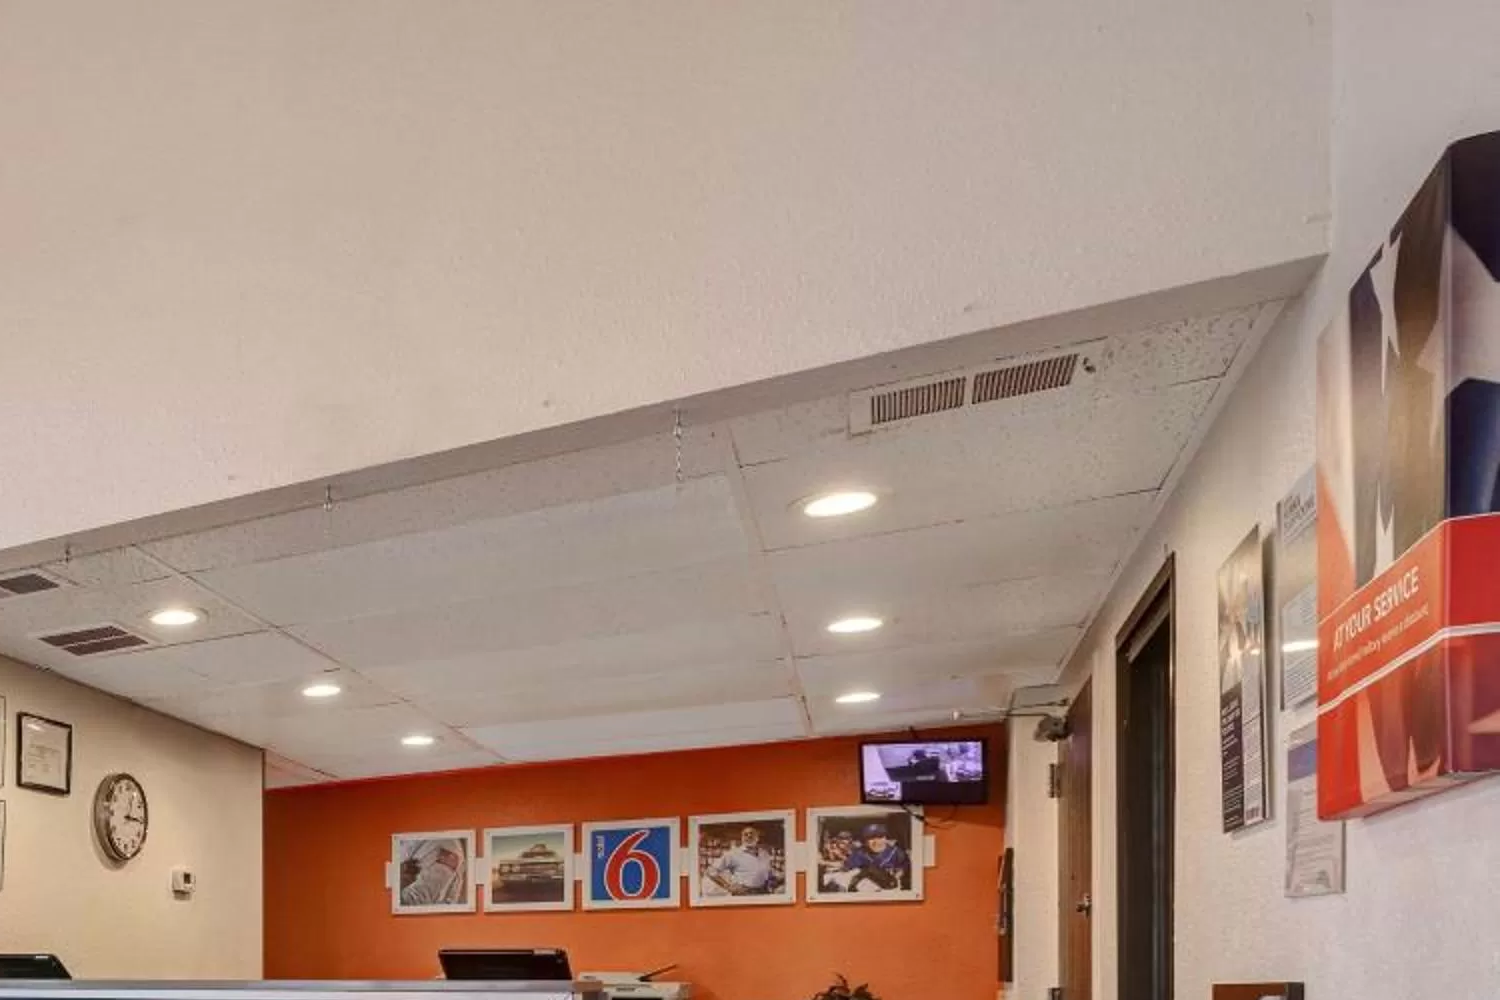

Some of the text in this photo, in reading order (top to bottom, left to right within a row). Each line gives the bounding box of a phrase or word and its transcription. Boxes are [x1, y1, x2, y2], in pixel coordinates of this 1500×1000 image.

[1343, 603, 1371, 642] YOUR
[1373, 565, 1419, 622] SERVICE
[604, 829, 661, 902] 6
